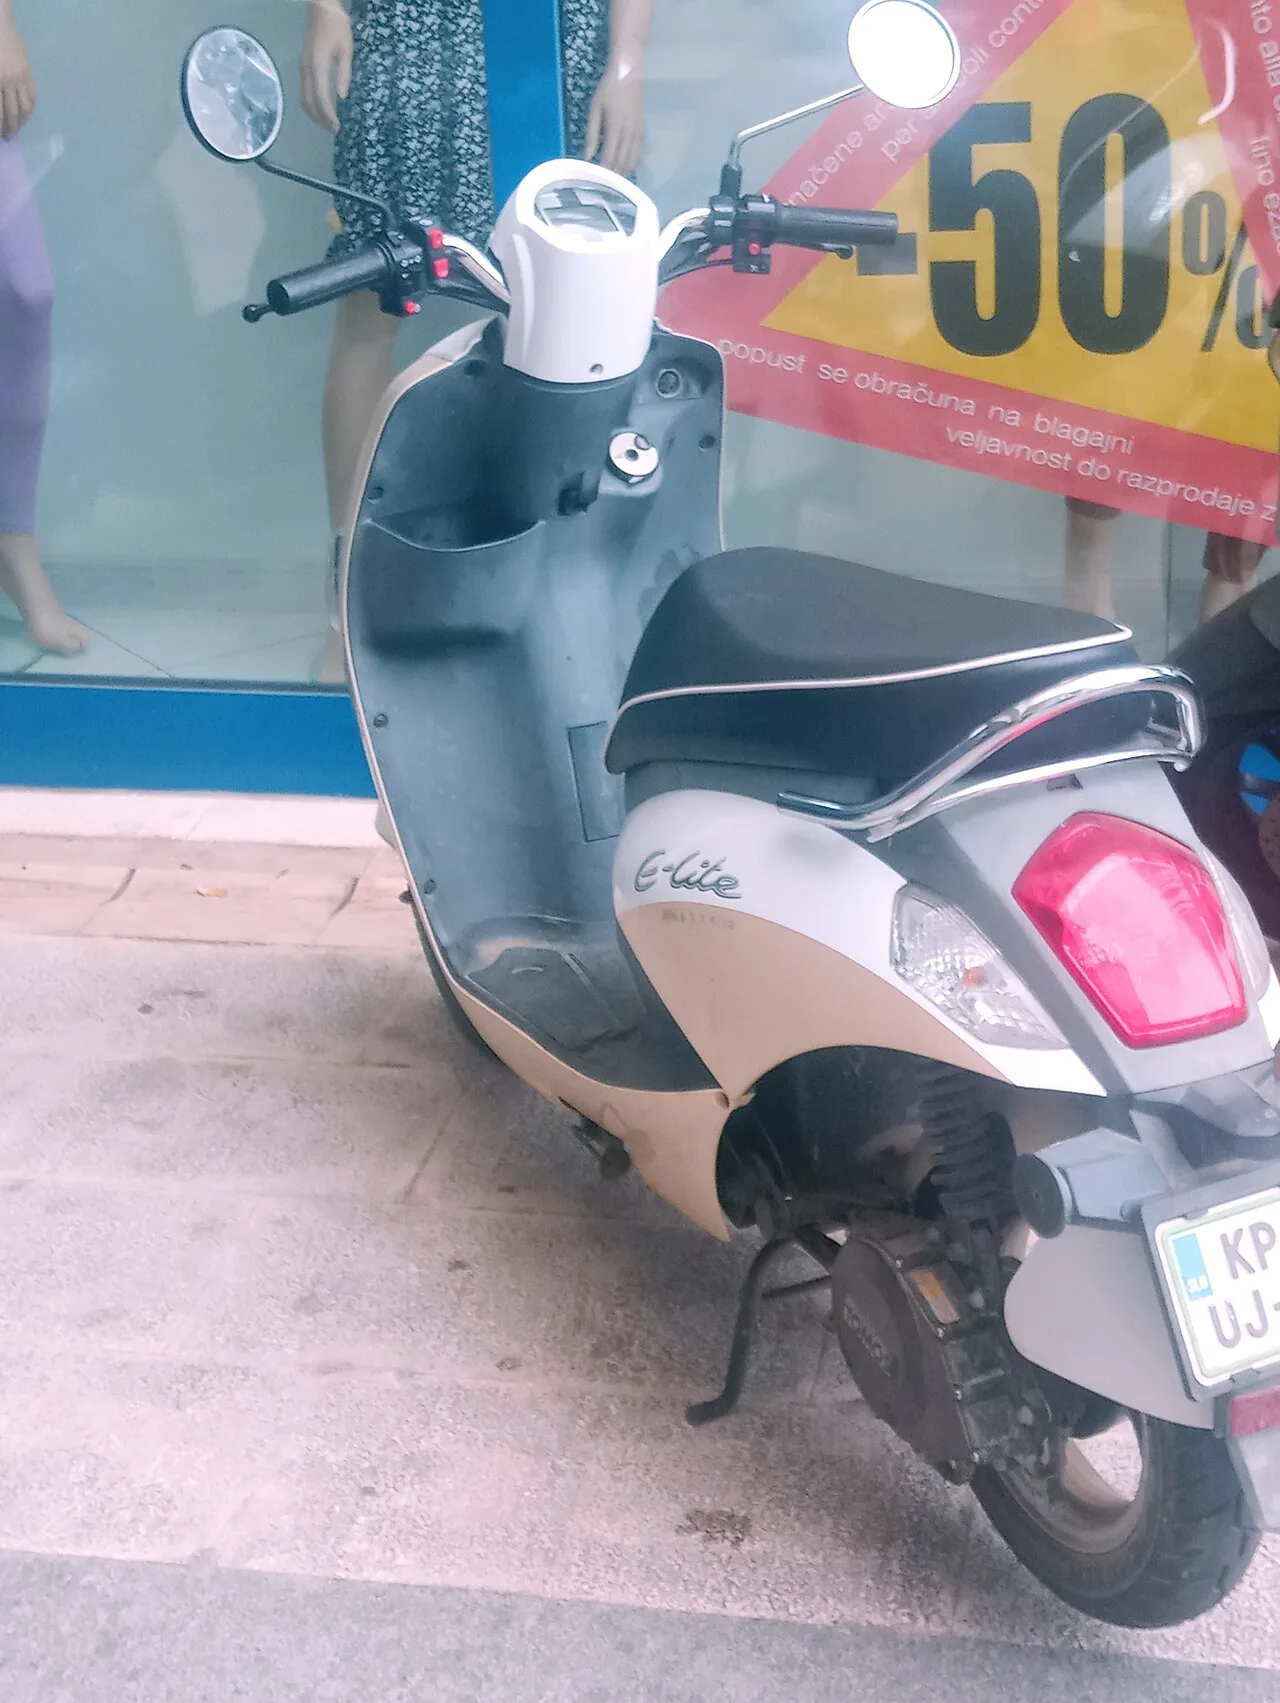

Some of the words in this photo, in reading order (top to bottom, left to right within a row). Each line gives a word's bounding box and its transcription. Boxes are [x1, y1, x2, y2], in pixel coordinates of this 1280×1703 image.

[783, 129, 864, 208] načene
[881, 119, 919, 163] per
[717, 338, 807, 375] popust
[816, 362, 849, 384] se
[854, 371, 976, 416] obračuna
[987, 404, 1022, 428] na
[1033, 411, 1135, 455] blagajni
[946, 425, 1073, 472] veljavnost
[1076, 456, 1112, 481] do
[1116, 468, 1256, 517] razprodaje
[634, 849, 742, 899] E-lite
[1220, 1220, 1278, 1280] KP
